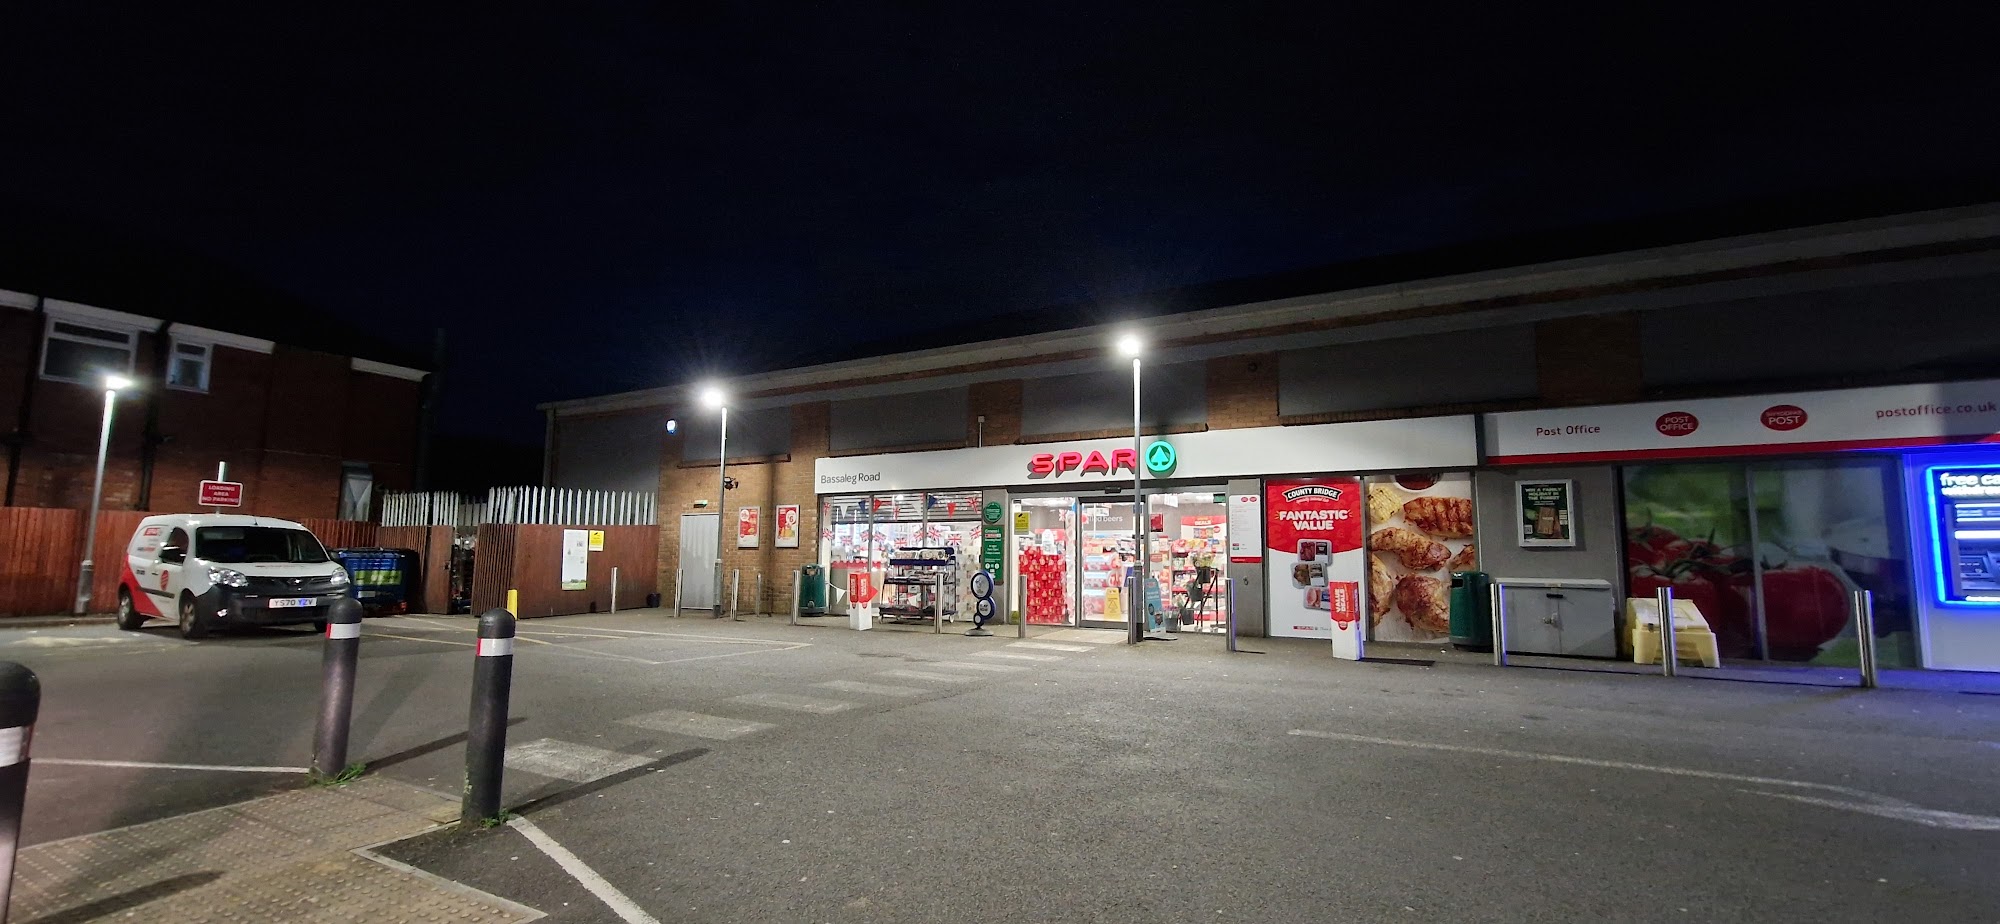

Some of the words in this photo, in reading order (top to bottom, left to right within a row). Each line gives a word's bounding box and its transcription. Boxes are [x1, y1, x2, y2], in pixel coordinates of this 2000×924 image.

[1875, 401, 1997, 420] postoffice.co.uk
[1665, 415, 1690, 424] POST
[1768, 415, 1800, 425] POST
[1536, 427, 1561, 437] Post
[1566, 424, 1600, 435] Office
[1660, 422, 1694, 431] OFFICE
[1030, 448, 1137, 475] SPAR
[820, 473, 857, 485] Bassaleg
[858, 472, 881, 482] Road
[1940, 473, 1978, 486] free
[1287, 488, 1313, 499] COUNTY
[1313, 488, 1338, 498] BRIDGE
[1279, 510, 1348, 521] FANTASTIC
[1292, 520, 1335, 531] VALUE
[274, 599, 296, 607] YS70
[298, 598, 313, 606] YZV
